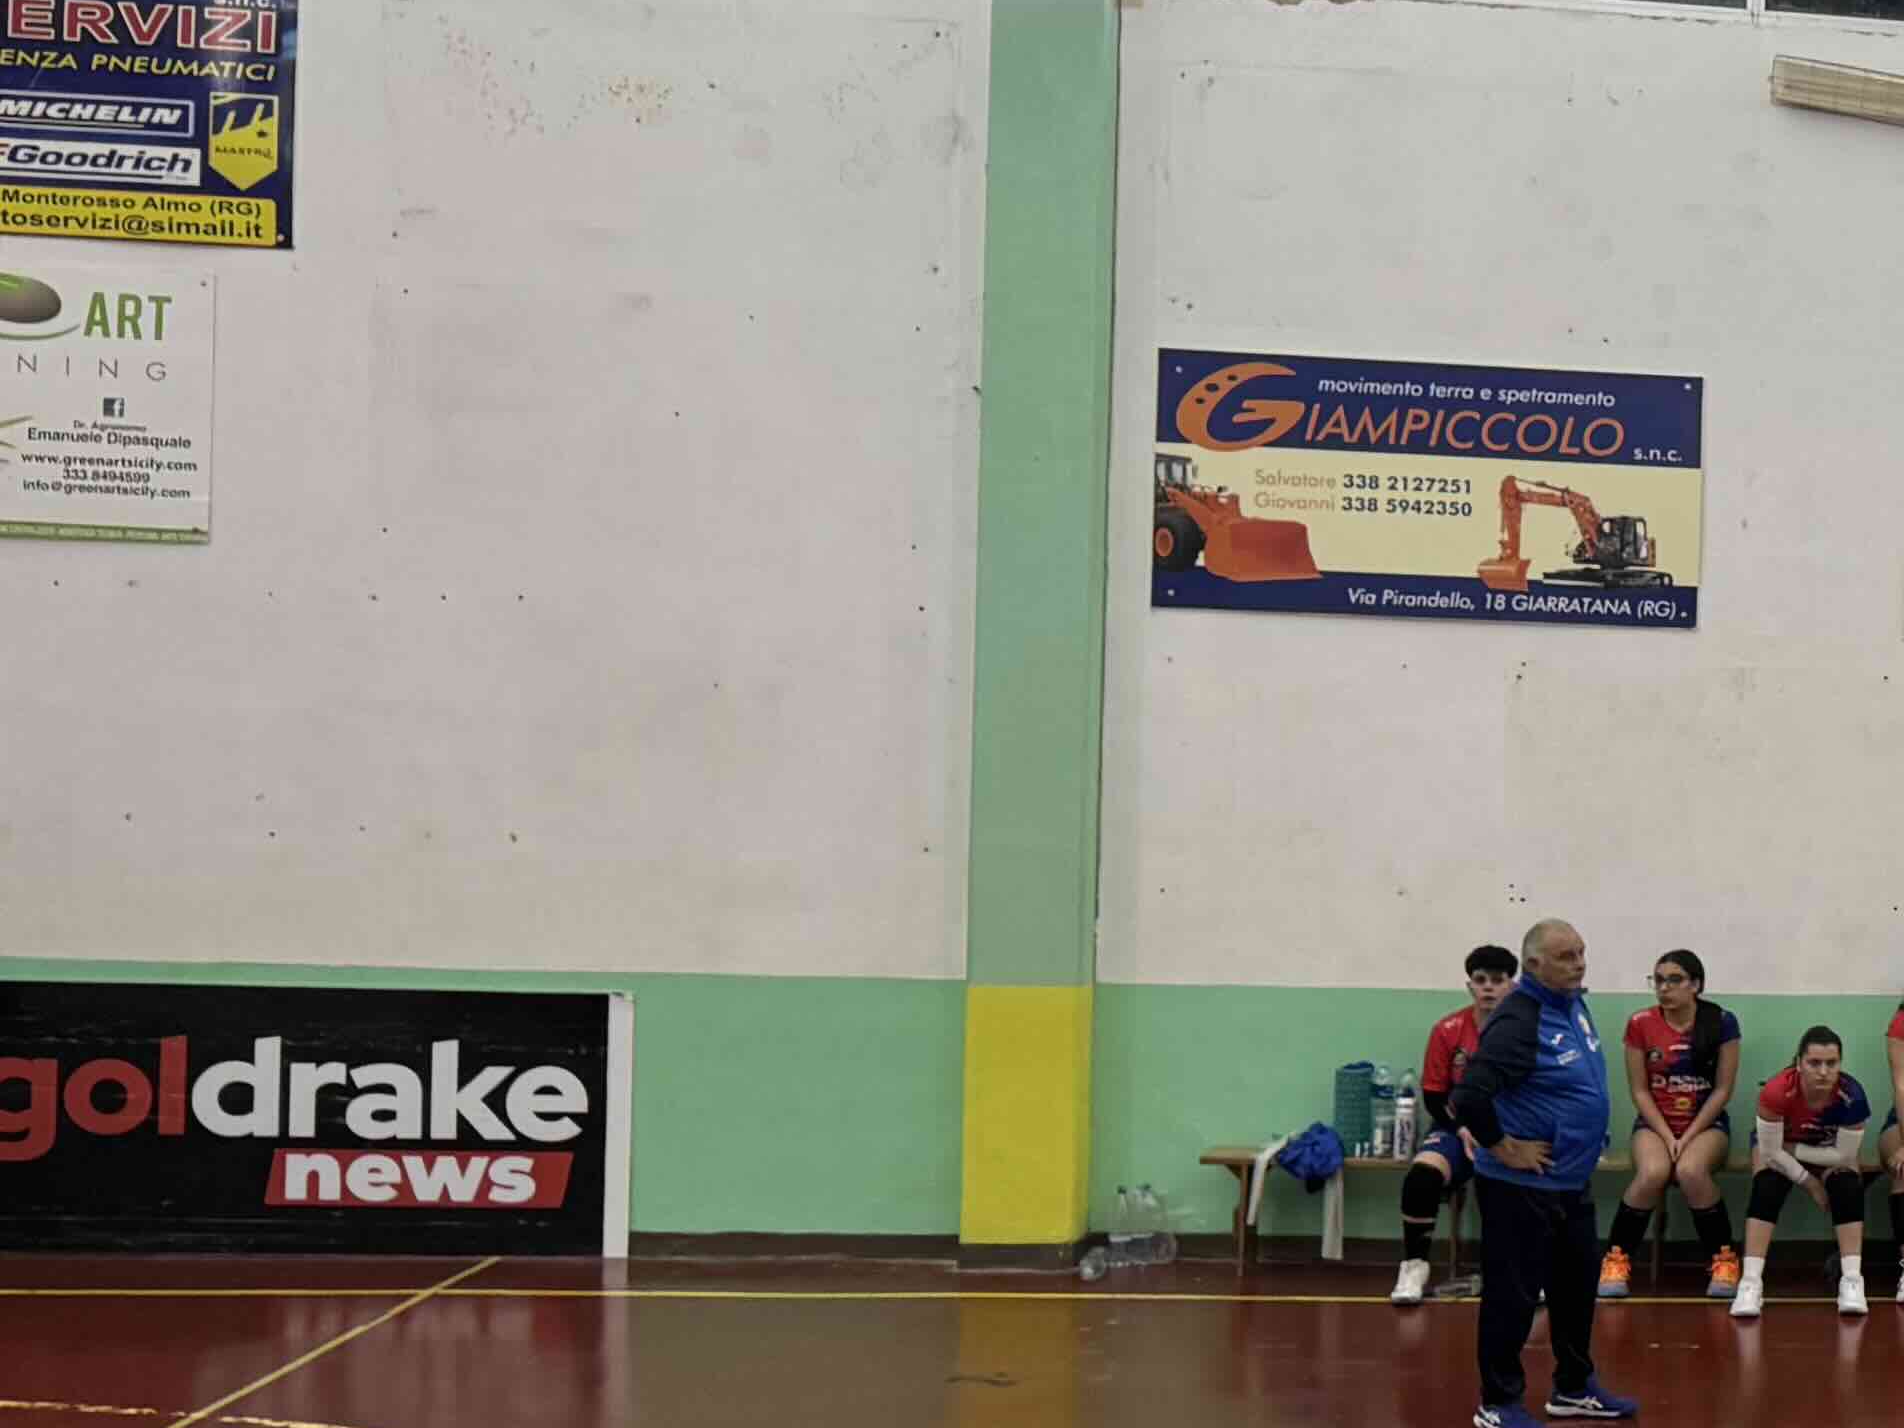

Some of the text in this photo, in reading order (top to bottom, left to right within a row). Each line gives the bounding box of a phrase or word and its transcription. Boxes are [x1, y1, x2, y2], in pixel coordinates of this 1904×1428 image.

[91, 54, 276, 82] PNEUMATICI
[0, 97, 183, 125] MICHELIN
[0, 143, 193, 174] Goodrich
[1, 188, 262, 219] Monterosso Almo (RG)
[84, 291, 174, 342] ART
[1317, 376, 1616, 408] movimento terra e spetramento
[1176, 362, 1626, 456] GIAMPICCOLO
[1633, 447, 1683, 463] s.n.c.
[1254, 469, 1472, 494] Salvatore 338 2127251
[1254, 492, 1473, 517] Giovanni 338 5942350
[1348, 587, 1377, 606] Via
[1381, 588, 1475, 611] Pirandello,
[1484, 594, 1507, 611] 18
[1511, 594, 1632, 616] GIARRATANA
[283, 1151, 537, 1204] news
